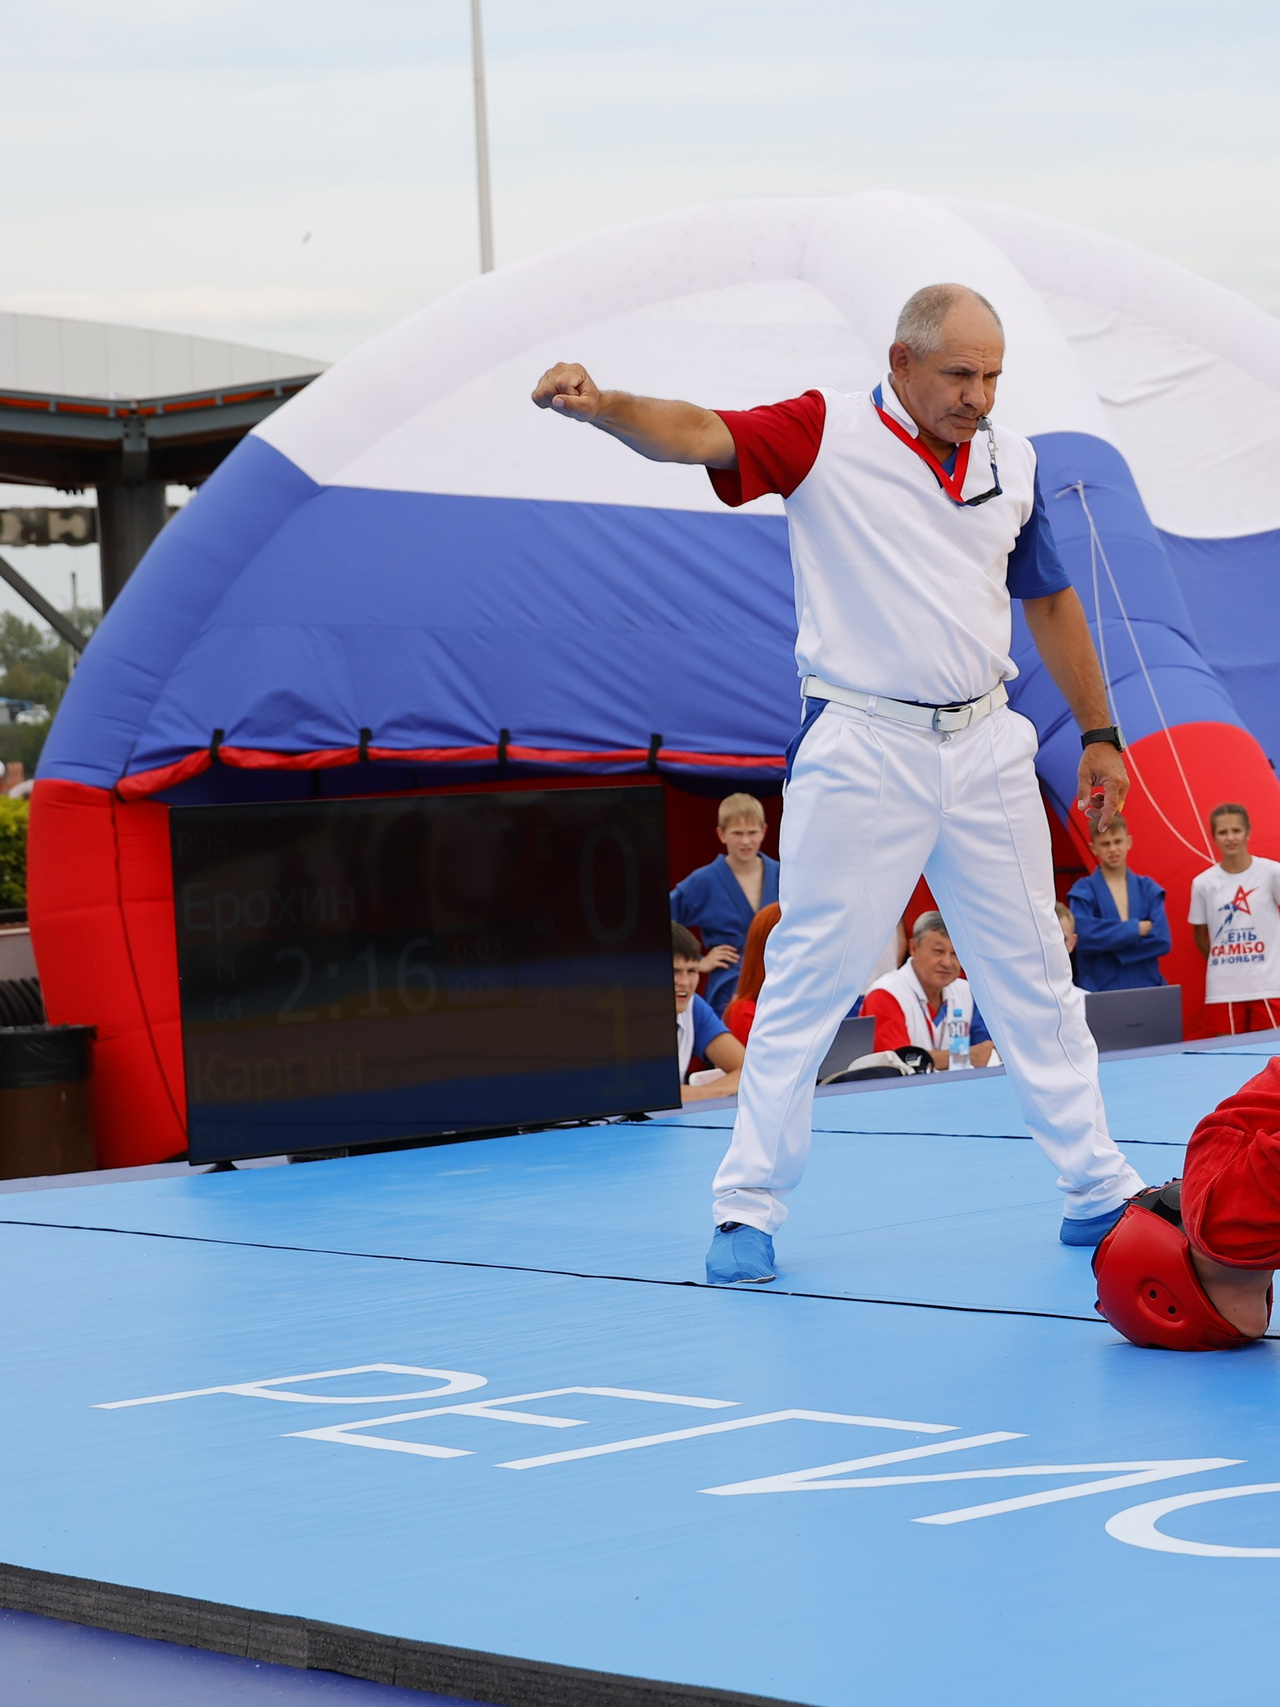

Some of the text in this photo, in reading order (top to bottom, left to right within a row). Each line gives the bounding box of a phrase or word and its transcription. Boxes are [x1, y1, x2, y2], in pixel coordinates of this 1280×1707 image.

[177, 830, 227, 857] RUS
[182, 881, 356, 943] Ерохин
[454, 935, 503, 961] 0:03
[1221, 931, 1257, 944] ЕНЬ
[275, 937, 438, 1024] 2:16
[214, 996, 243, 1022] 64
[192, 1049, 364, 1108] Каргин
